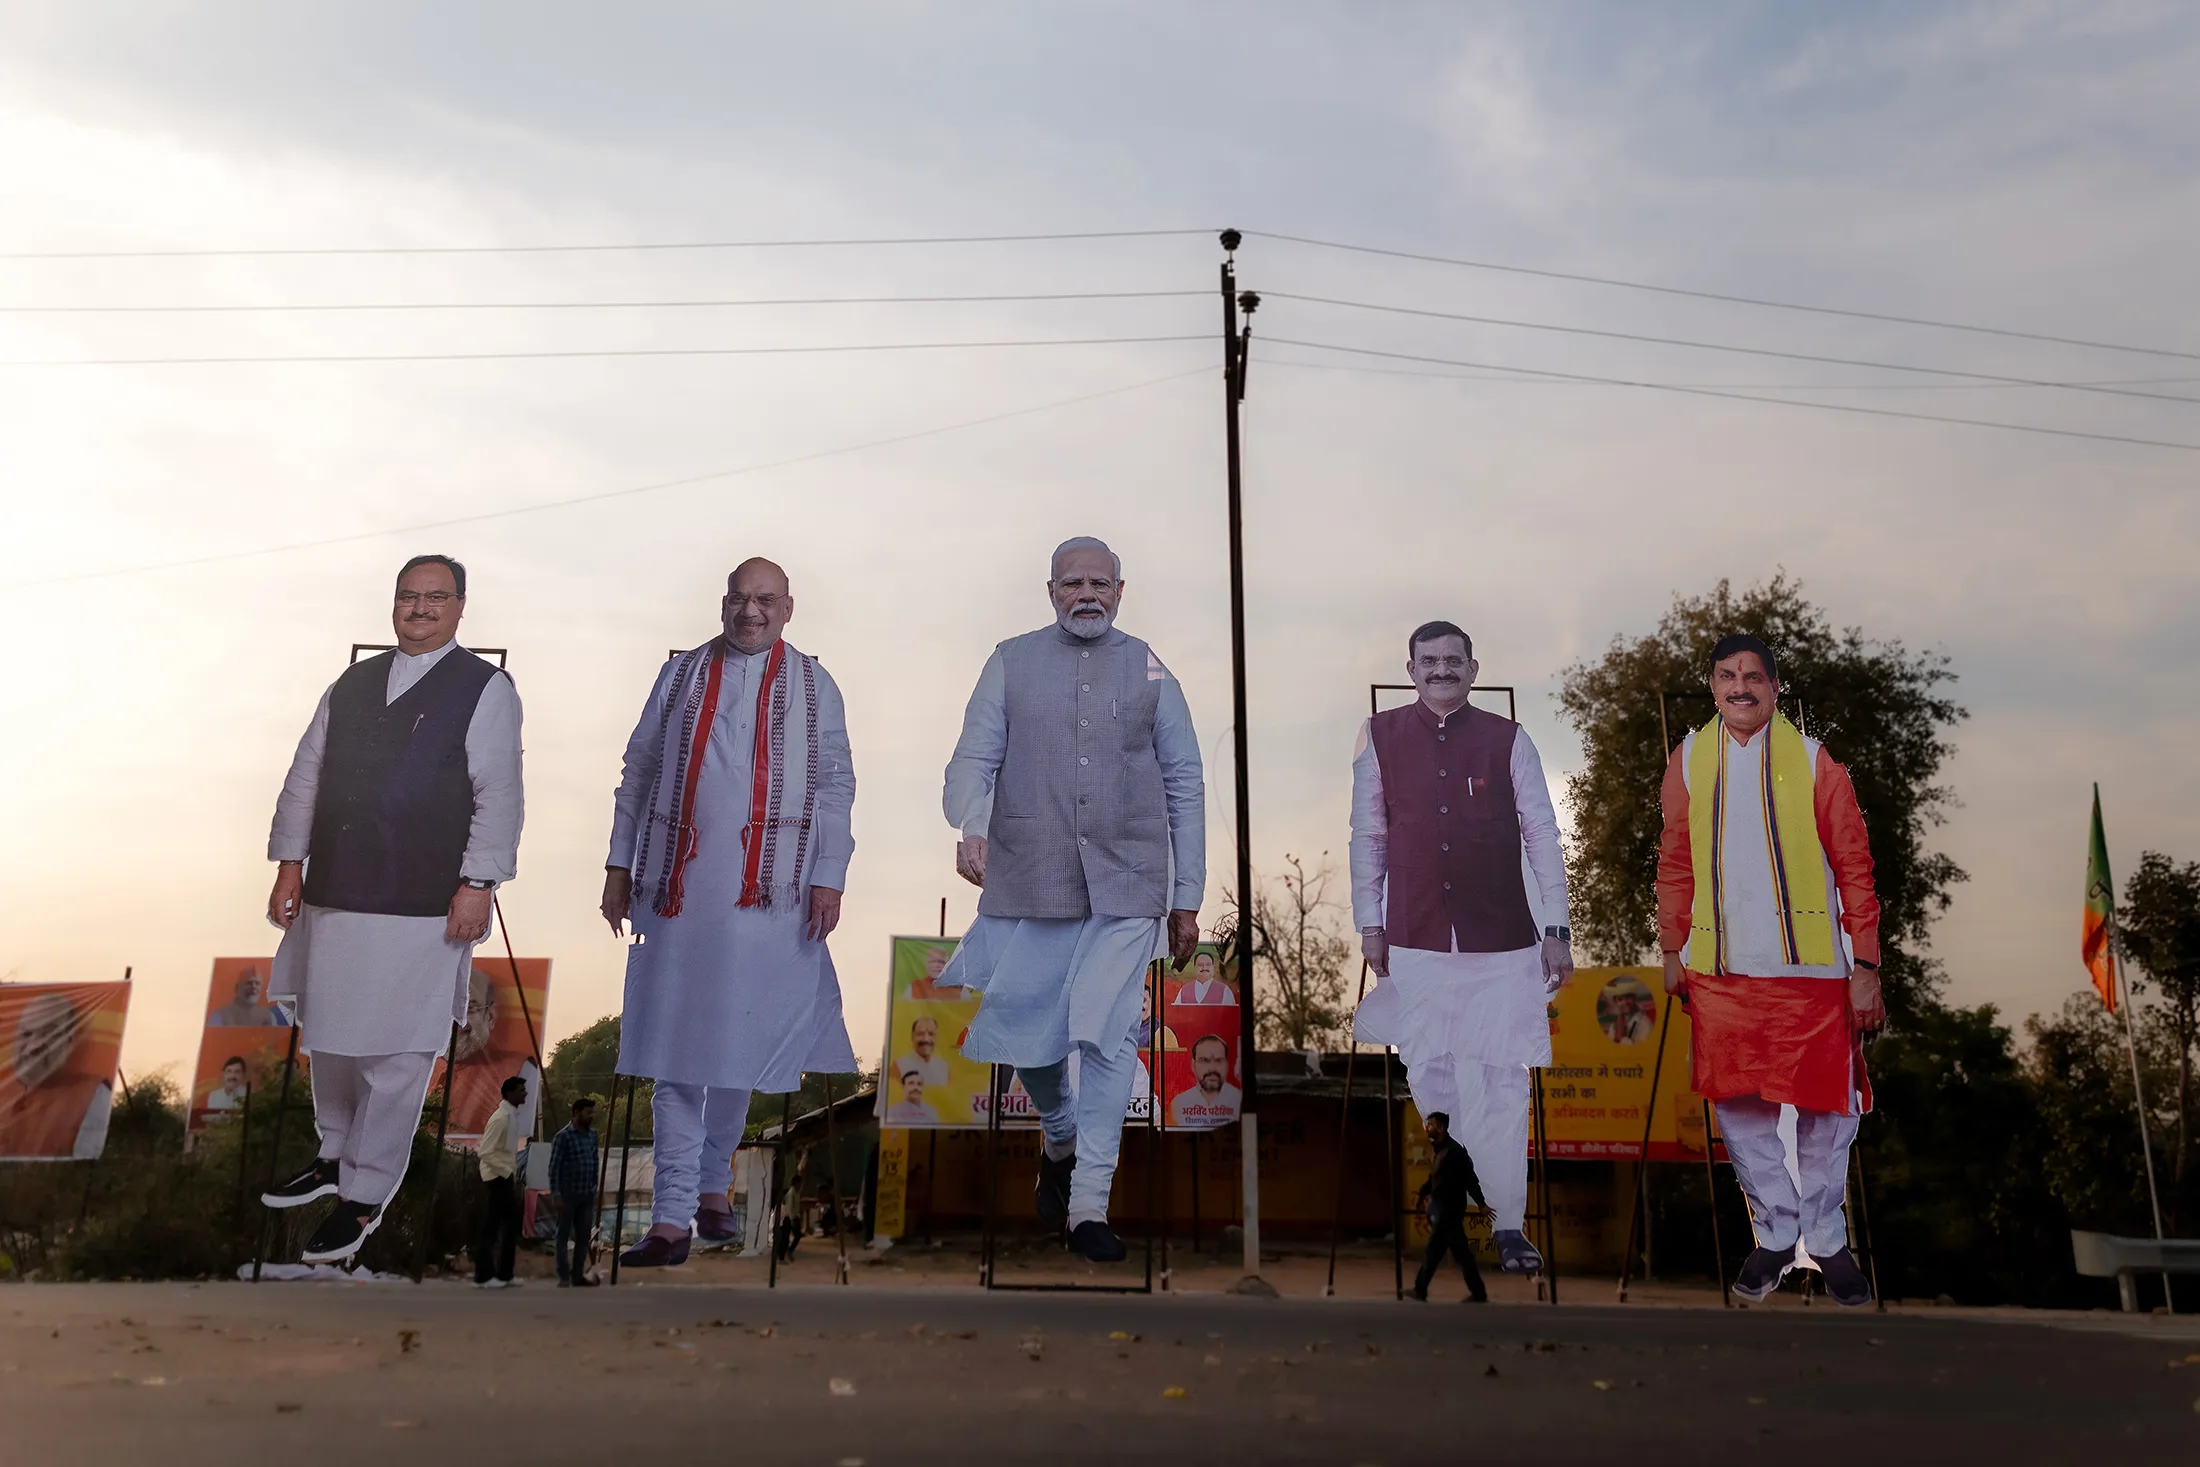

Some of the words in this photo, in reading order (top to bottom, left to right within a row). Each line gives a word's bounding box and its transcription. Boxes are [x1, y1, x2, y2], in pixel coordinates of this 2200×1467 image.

[1550, 1084, 1576, 1099] सभी
[1580, 1087, 1597, 1099] का
[1182, 1104, 1207, 1116] अरविंद
